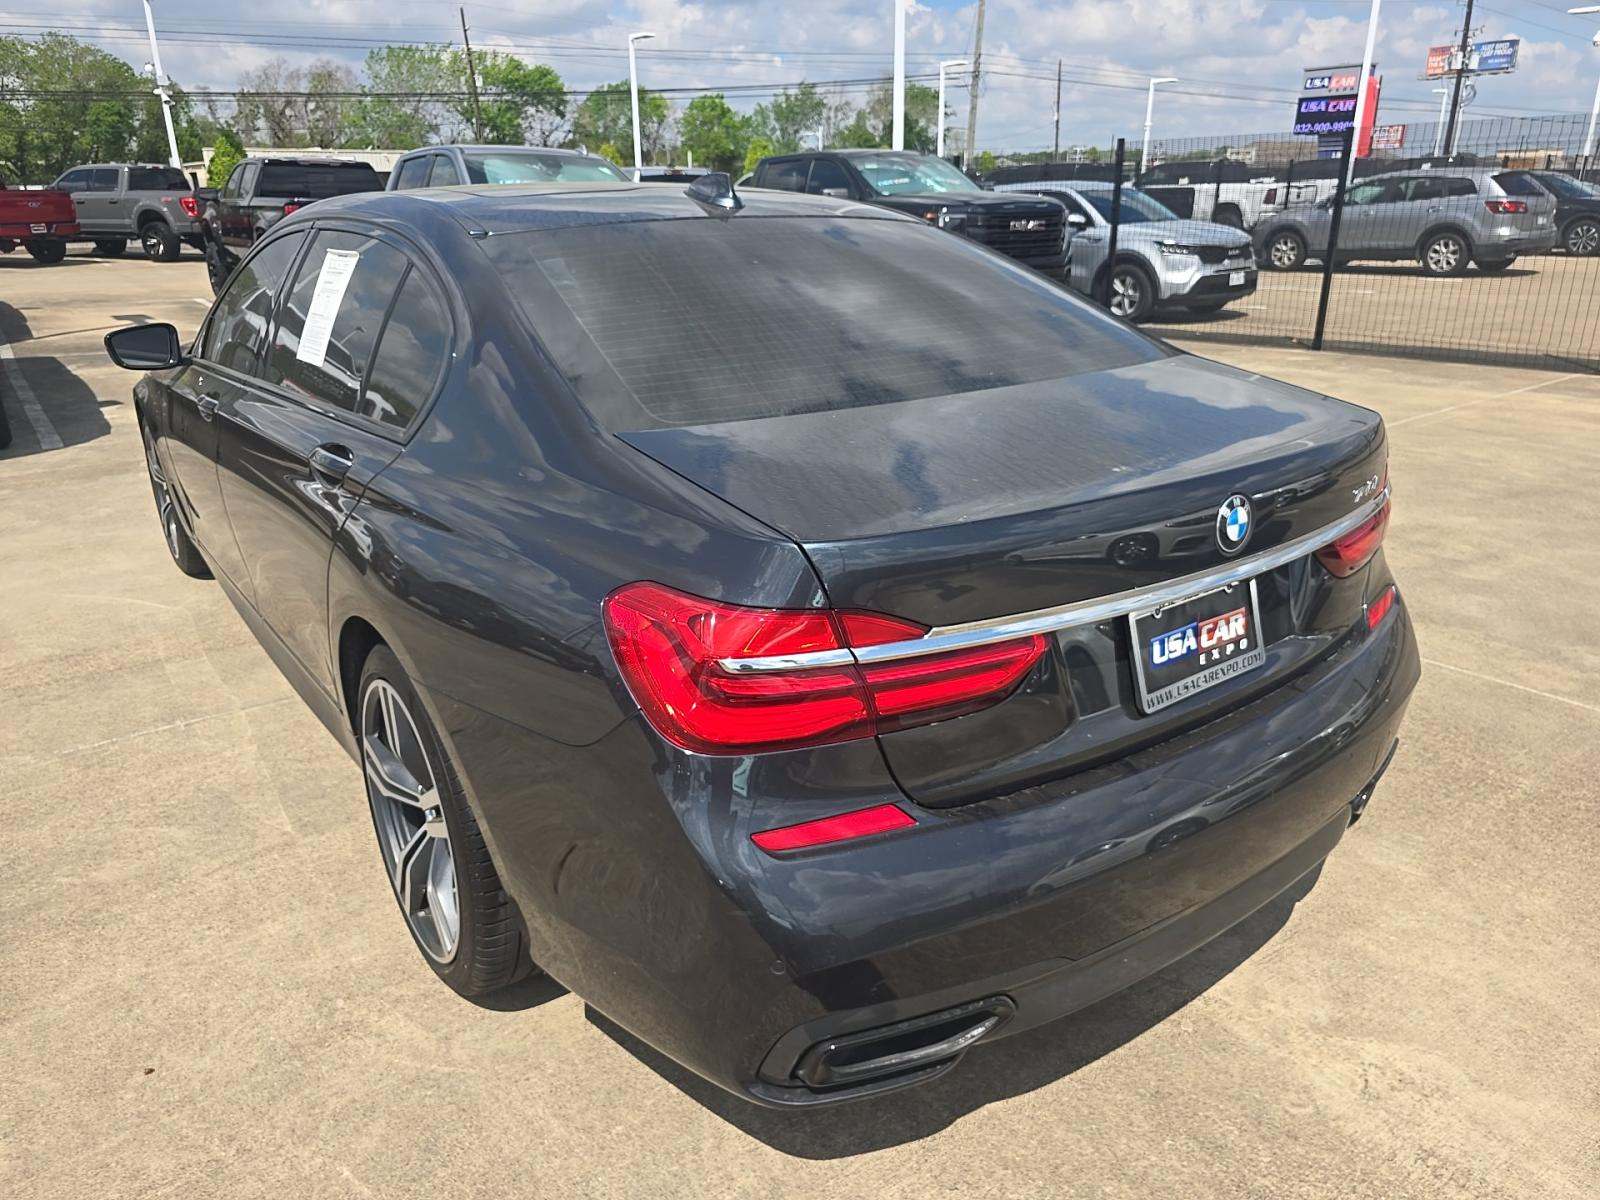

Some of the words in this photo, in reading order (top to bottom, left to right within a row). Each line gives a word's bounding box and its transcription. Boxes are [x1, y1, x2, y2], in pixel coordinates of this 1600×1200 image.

[1305, 77, 1329, 88] USA
[1329, 75, 1356, 88] CAR
[1300, 101, 1327, 113] USA
[1327, 99, 1356, 112] CAR
[1010, 219, 1045, 231] GMC
[1152, 628, 1198, 665] USA
[1200, 613, 1246, 649] CAR
[1199, 638, 1248, 665] EXPO
